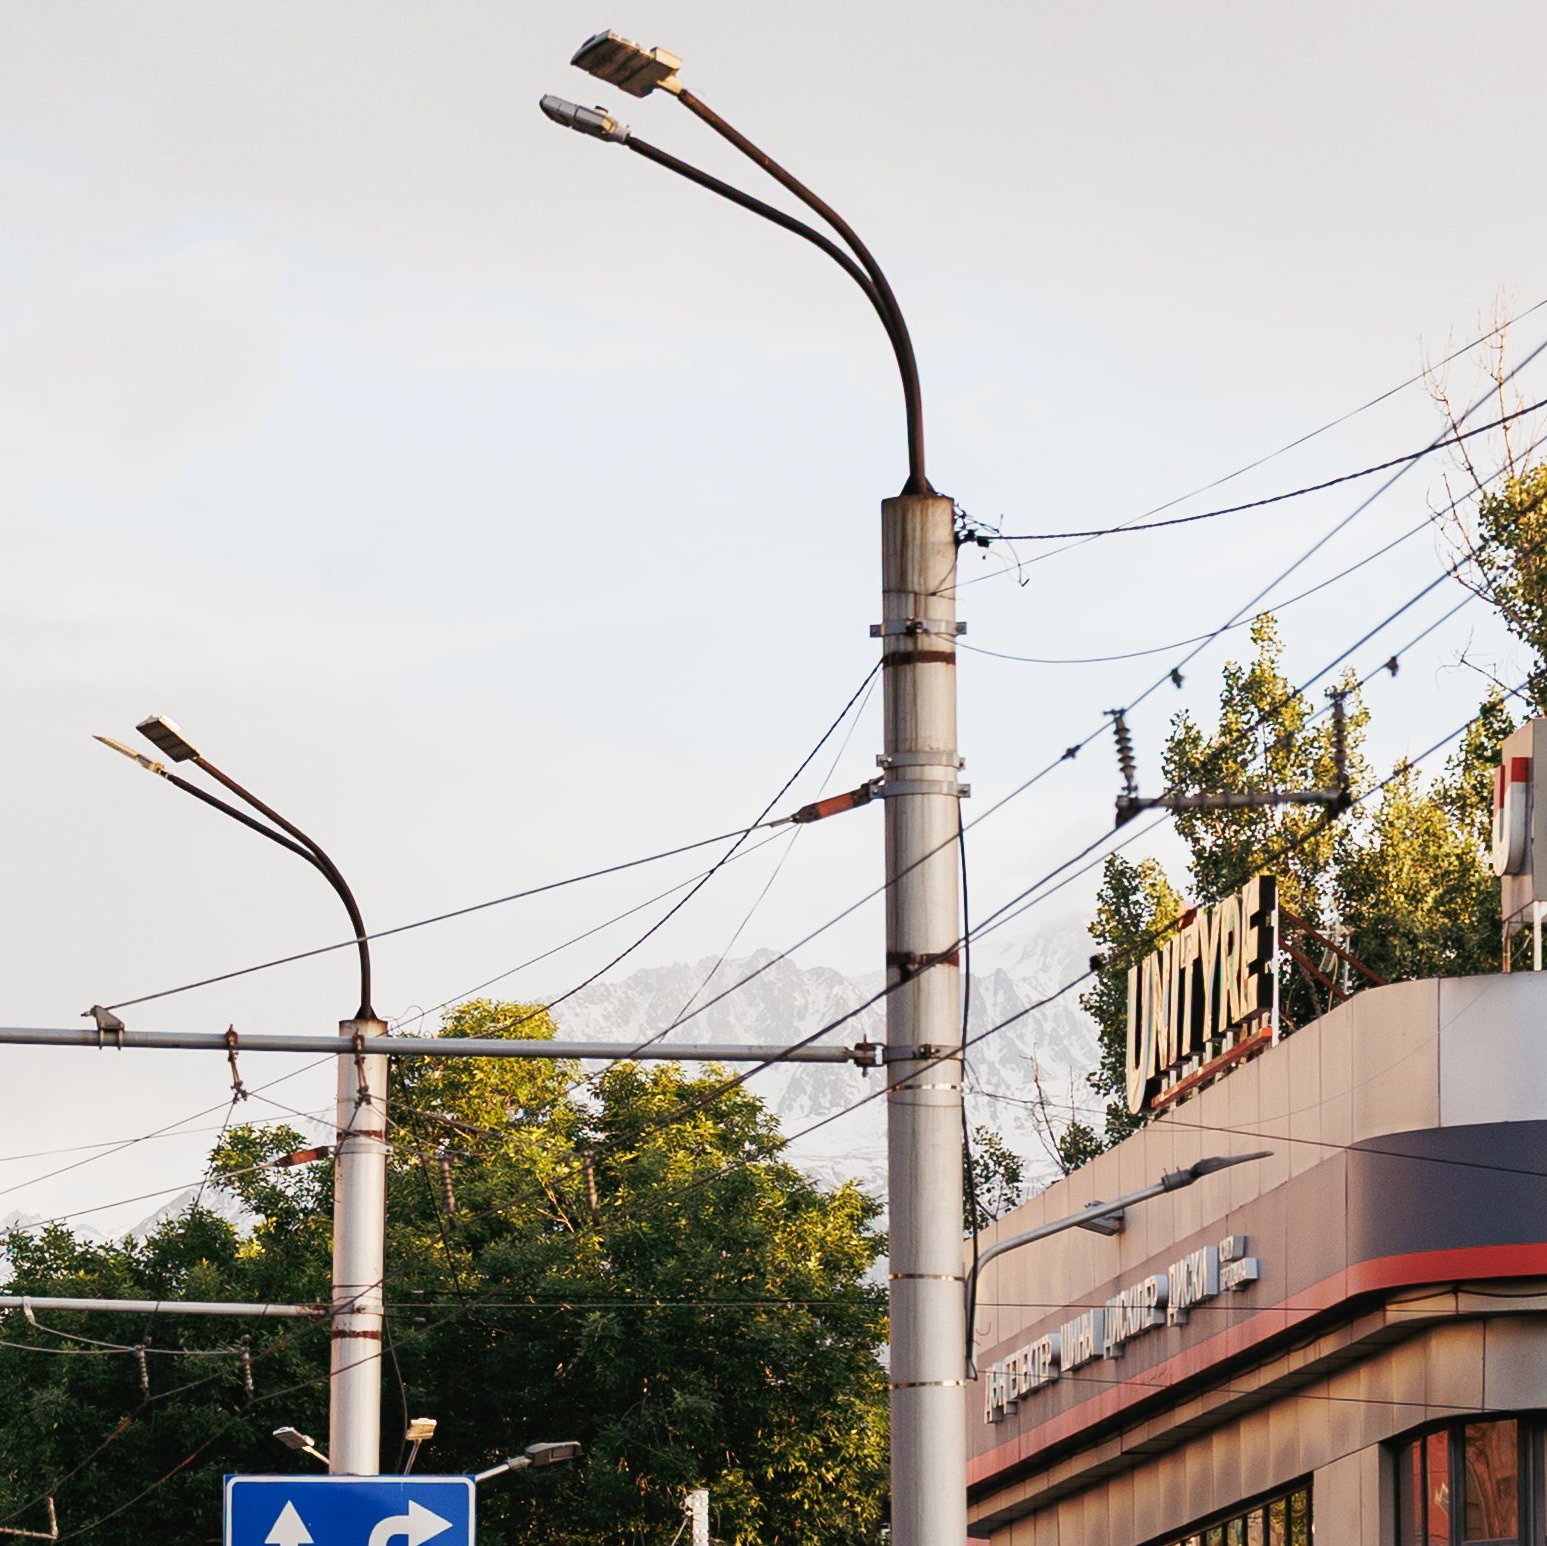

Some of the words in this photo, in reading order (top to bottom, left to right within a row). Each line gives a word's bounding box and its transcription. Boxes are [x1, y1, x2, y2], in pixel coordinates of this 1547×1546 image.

[1126, 876, 1261, 1114] UNITYRE
[1060, 1309, 1094, 1372] ШИНЫ
[1167, 1246, 1208, 1327] ДИСКИ
